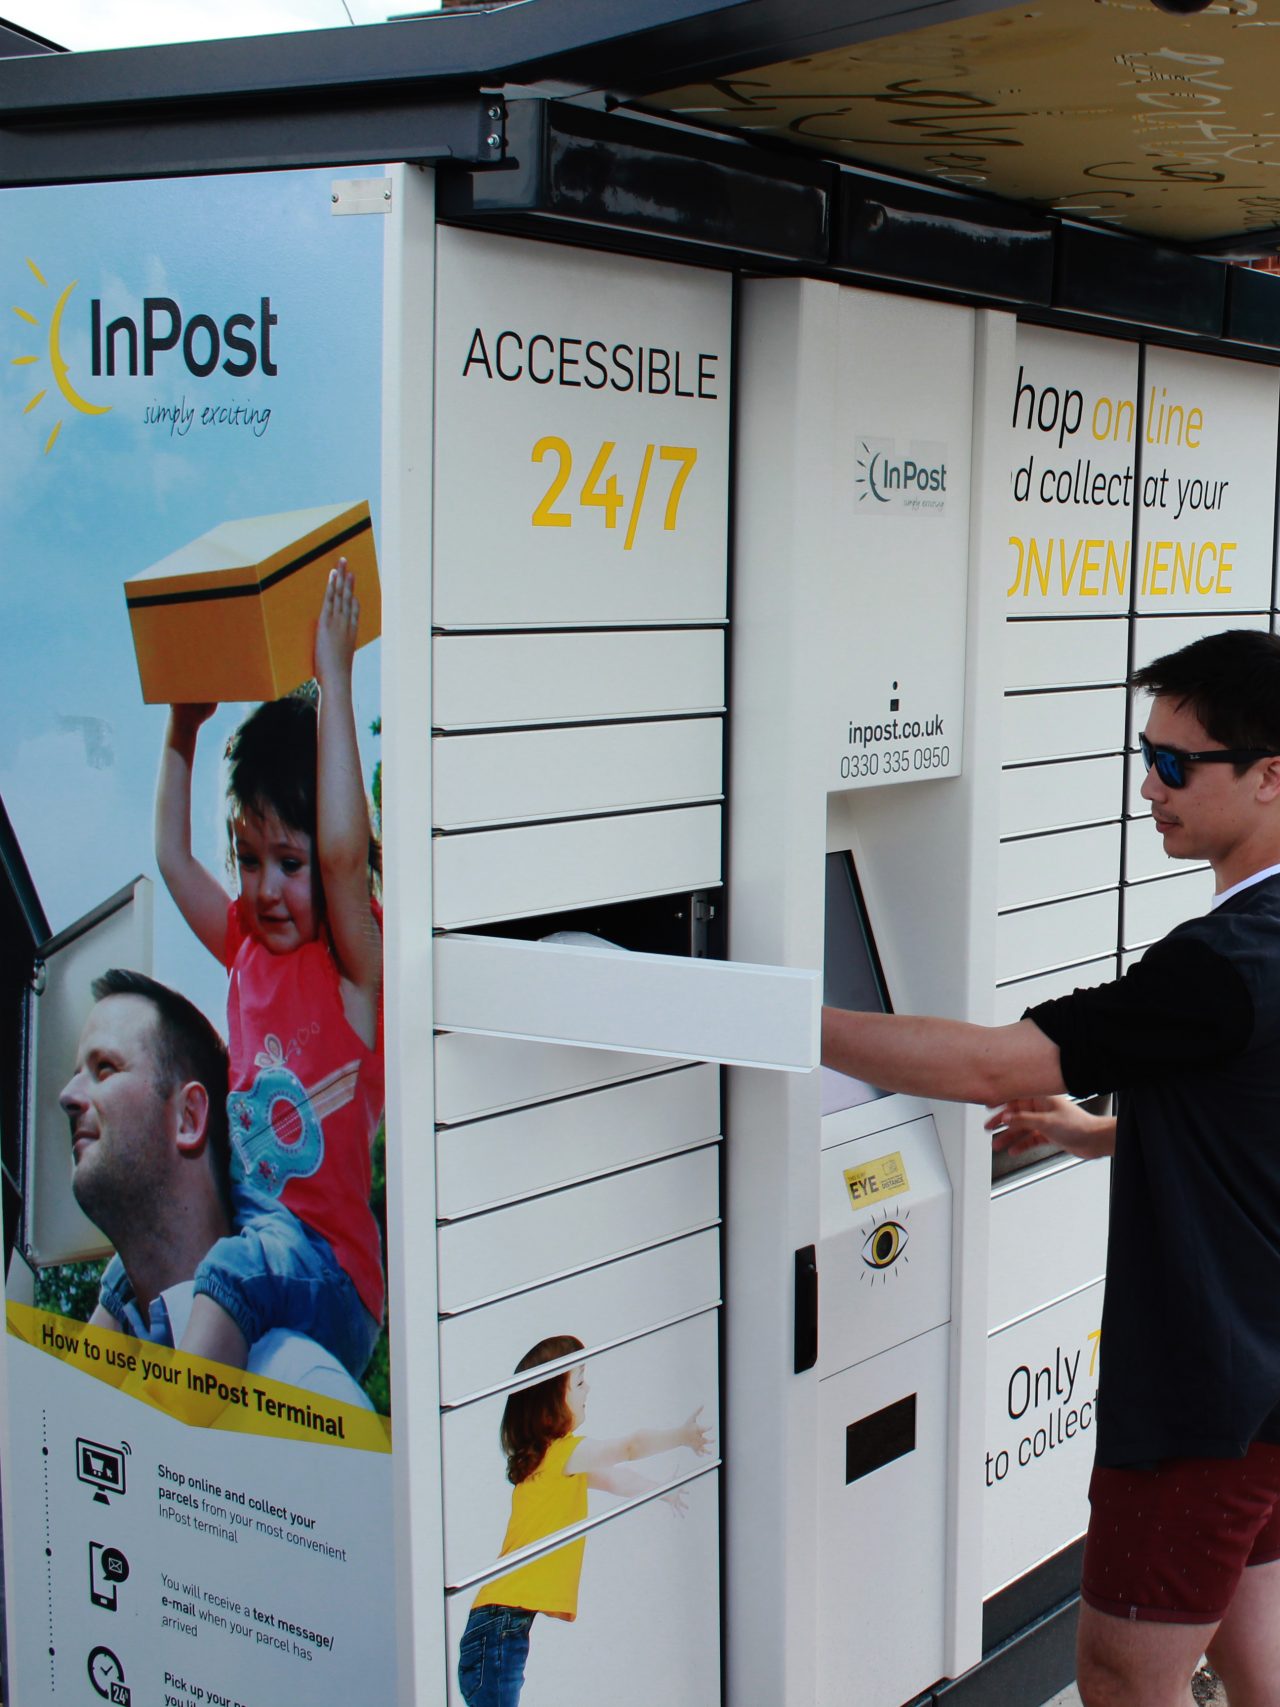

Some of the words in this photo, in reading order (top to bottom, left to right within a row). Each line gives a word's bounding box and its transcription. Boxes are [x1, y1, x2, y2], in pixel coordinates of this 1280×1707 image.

[91, 296, 278, 378] InPost
[462, 328, 719, 400] ACCESSIBLE
[143, 395, 195, 438] simply
[200, 398, 272, 438] exciting
[531, 435, 698, 551] 24/7
[883, 459, 947, 493] InPost
[1010, 455, 1034, 503] d
[1040, 459, 1133, 507] collect
[1143, 468, 1170, 508] at
[1173, 478, 1229, 520] your
[848, 714, 944, 748] inpost.co.uk
[840, 755, 879, 779] 0330
[882, 750, 910, 774] 335
[913, 746, 950, 770] 0950
[849, 1175, 880, 1200] EYE
[42, 1323, 79, 1354] How
[83, 1339, 101, 1361] to
[105, 1346, 137, 1372] use
[141, 1359, 182, 1385] your
[186, 1367, 249, 1408] InPost
[252, 1388, 346, 1440] Terminal
[1008, 1347, 1081, 1421] Only
[985, 1451, 1009, 1488] to
[158, 1464, 186, 1487] Shop
[188, 1475, 222, 1498] online
[225, 1486, 246, 1505] and
[249, 1496, 288, 1520] collect
[290, 1509, 317, 1530] your
[158, 1486, 199, 1509] parcels
[201, 1498, 227, 1518] from
[229, 1511, 253, 1529] your
[256, 1517, 284, 1539] most
[286, 1530, 347, 1562] convenient
[159, 1504, 192, 1529] InPost
[193, 1517, 239, 1544] terminal
[161, 1572, 180, 1591] You
[182, 1583, 200, 1600] will
[203, 1591, 242, 1615] receive
[244, 1606, 251, 1618] a
[253, 1608, 275, 1627] text
[277, 1619, 335, 1651] message/
[161, 1594, 196, 1617] e-mail
[199, 1608, 227, 1629] when
[229, 1619, 253, 1638] your
[256, 1629, 291, 1653] parcel
[292, 1641, 313, 1661] has
[162, 1614, 198, 1637] arrived
[164, 1671, 188, 1692] Pick
[190, 1684, 204, 1699] up
[207, 1690, 231, 1707] your
[164, 1693, 184, 1707] you
